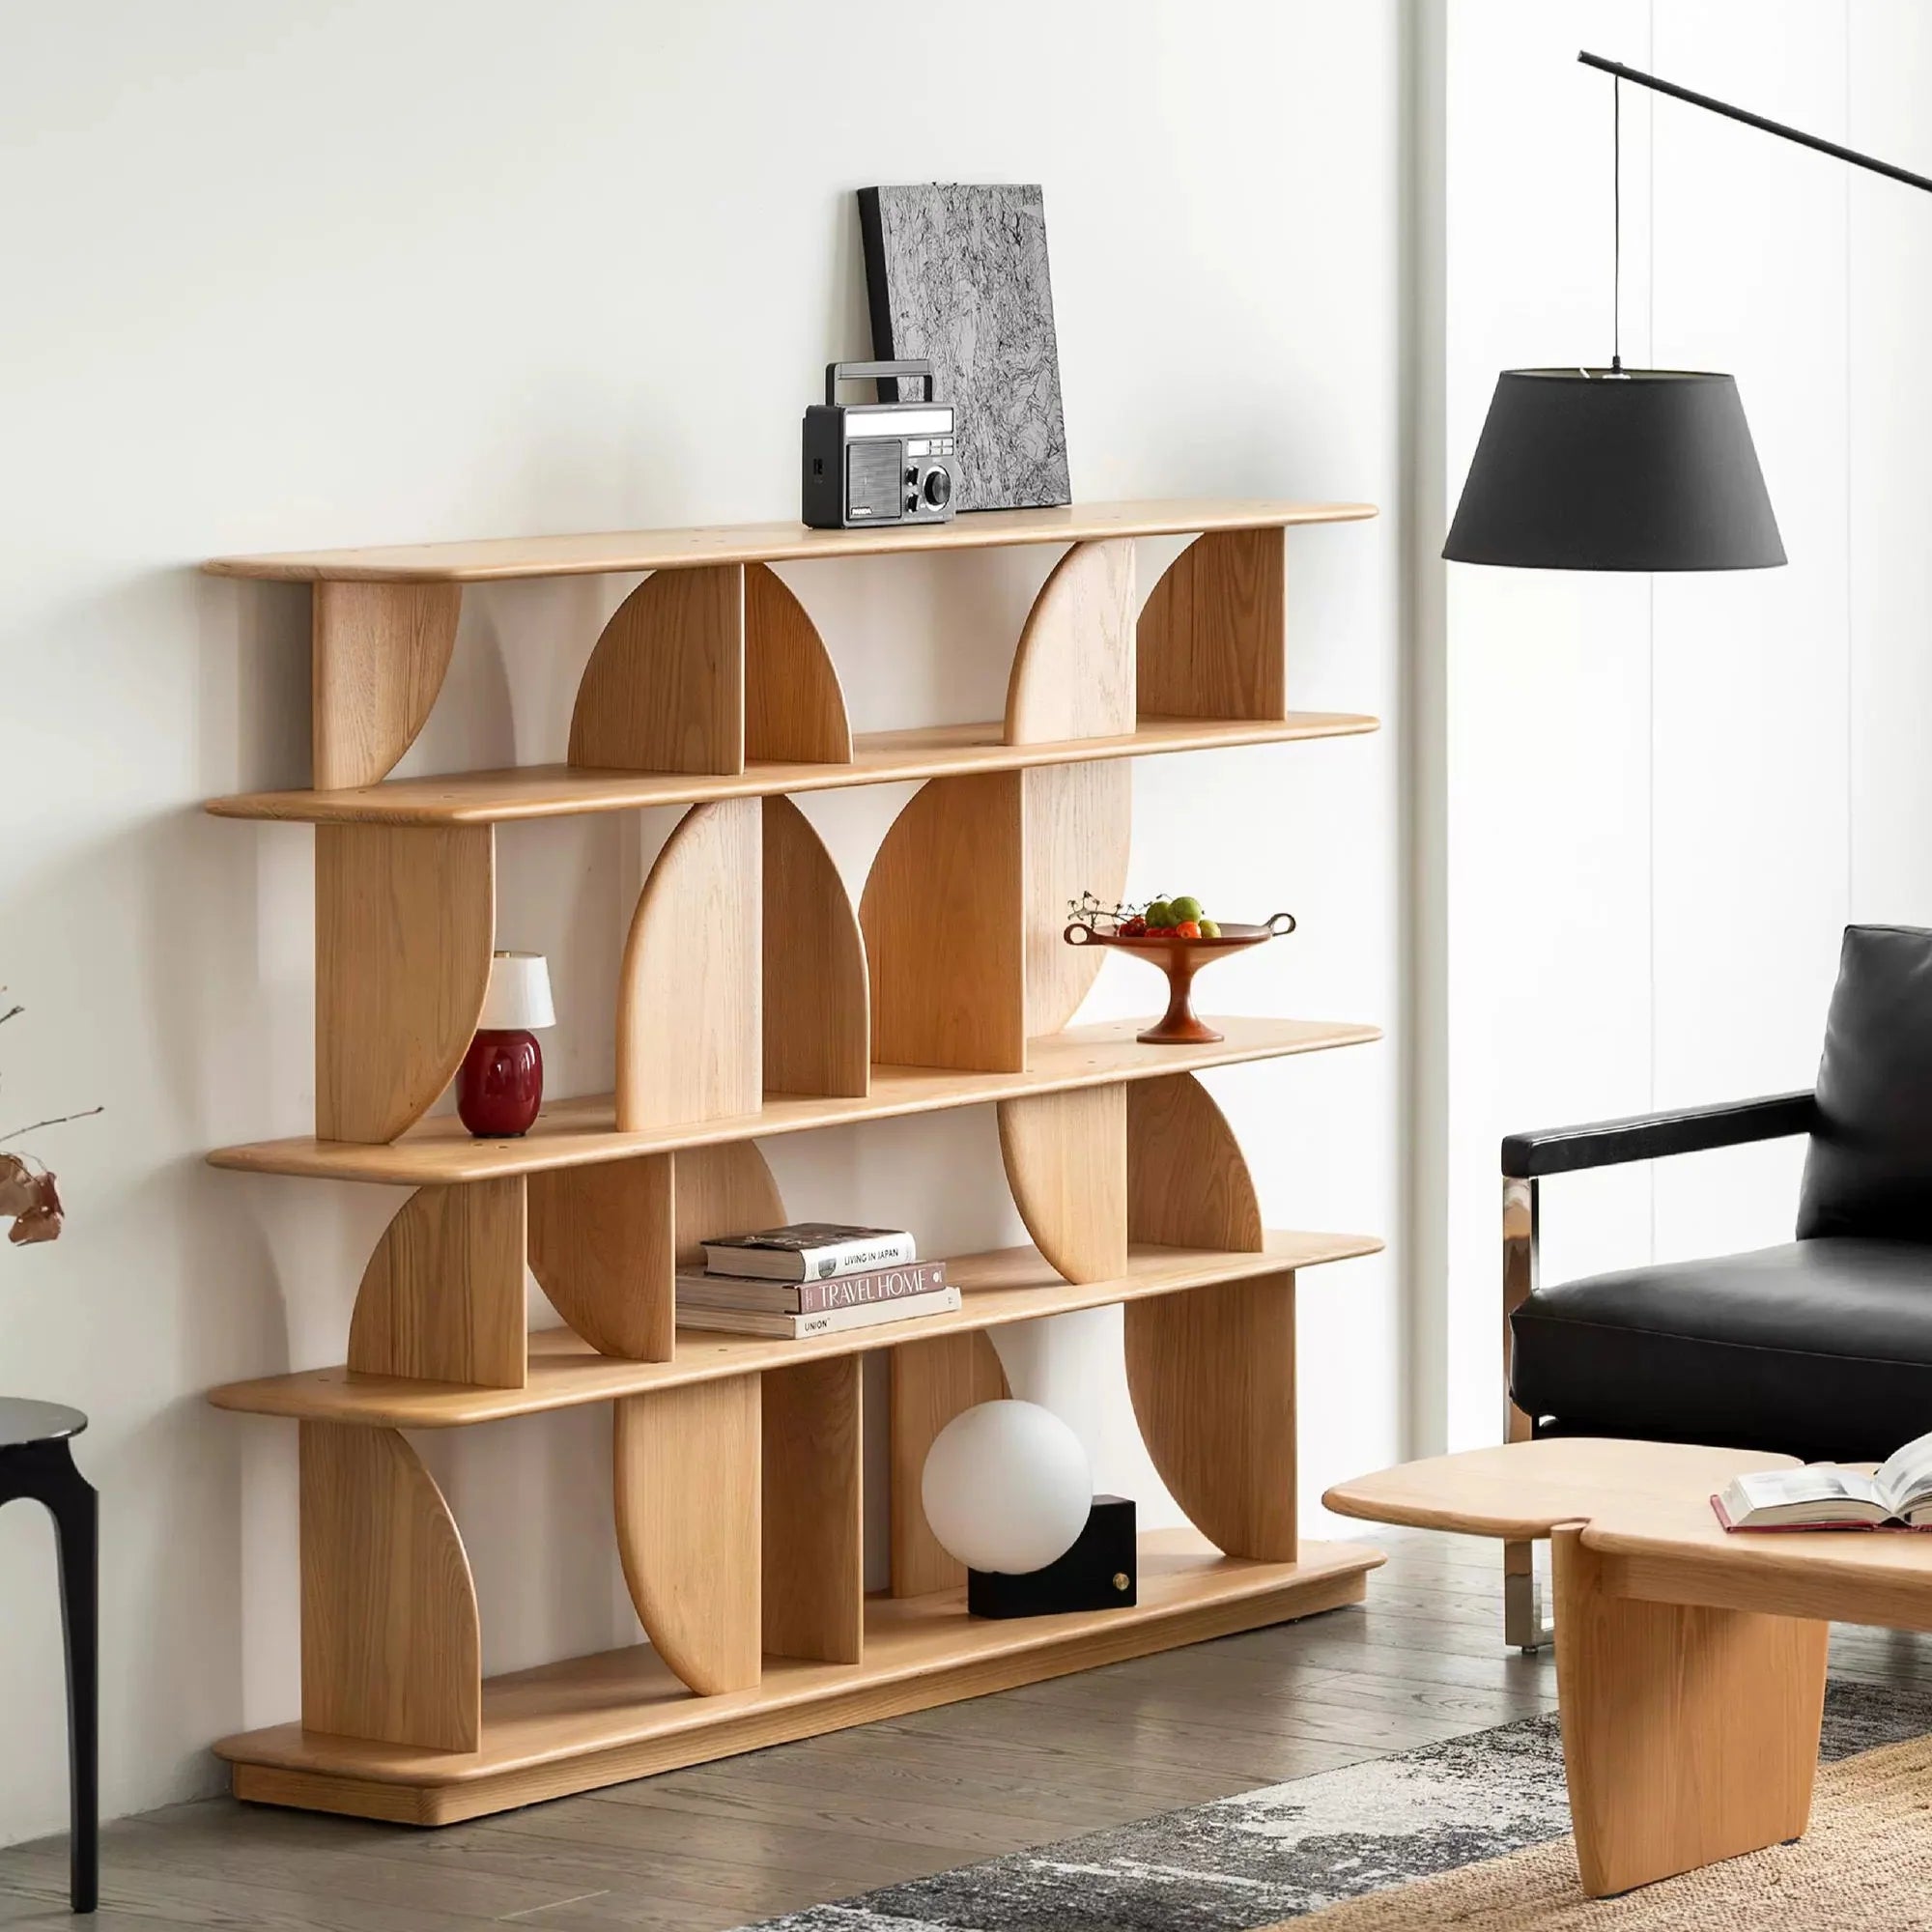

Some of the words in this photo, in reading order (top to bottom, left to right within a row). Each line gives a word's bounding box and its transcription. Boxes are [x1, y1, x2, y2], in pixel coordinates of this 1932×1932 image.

[844, 1254, 867, 1266] LIVING
[868, 1252, 876, 1262] IN
[877, 1249, 898, 1260] JAPAN
[819, 1278, 875, 1308] TRAVEL
[878, 1268, 927, 1298] HOME
[804, 1320, 828, 1331] UNION
